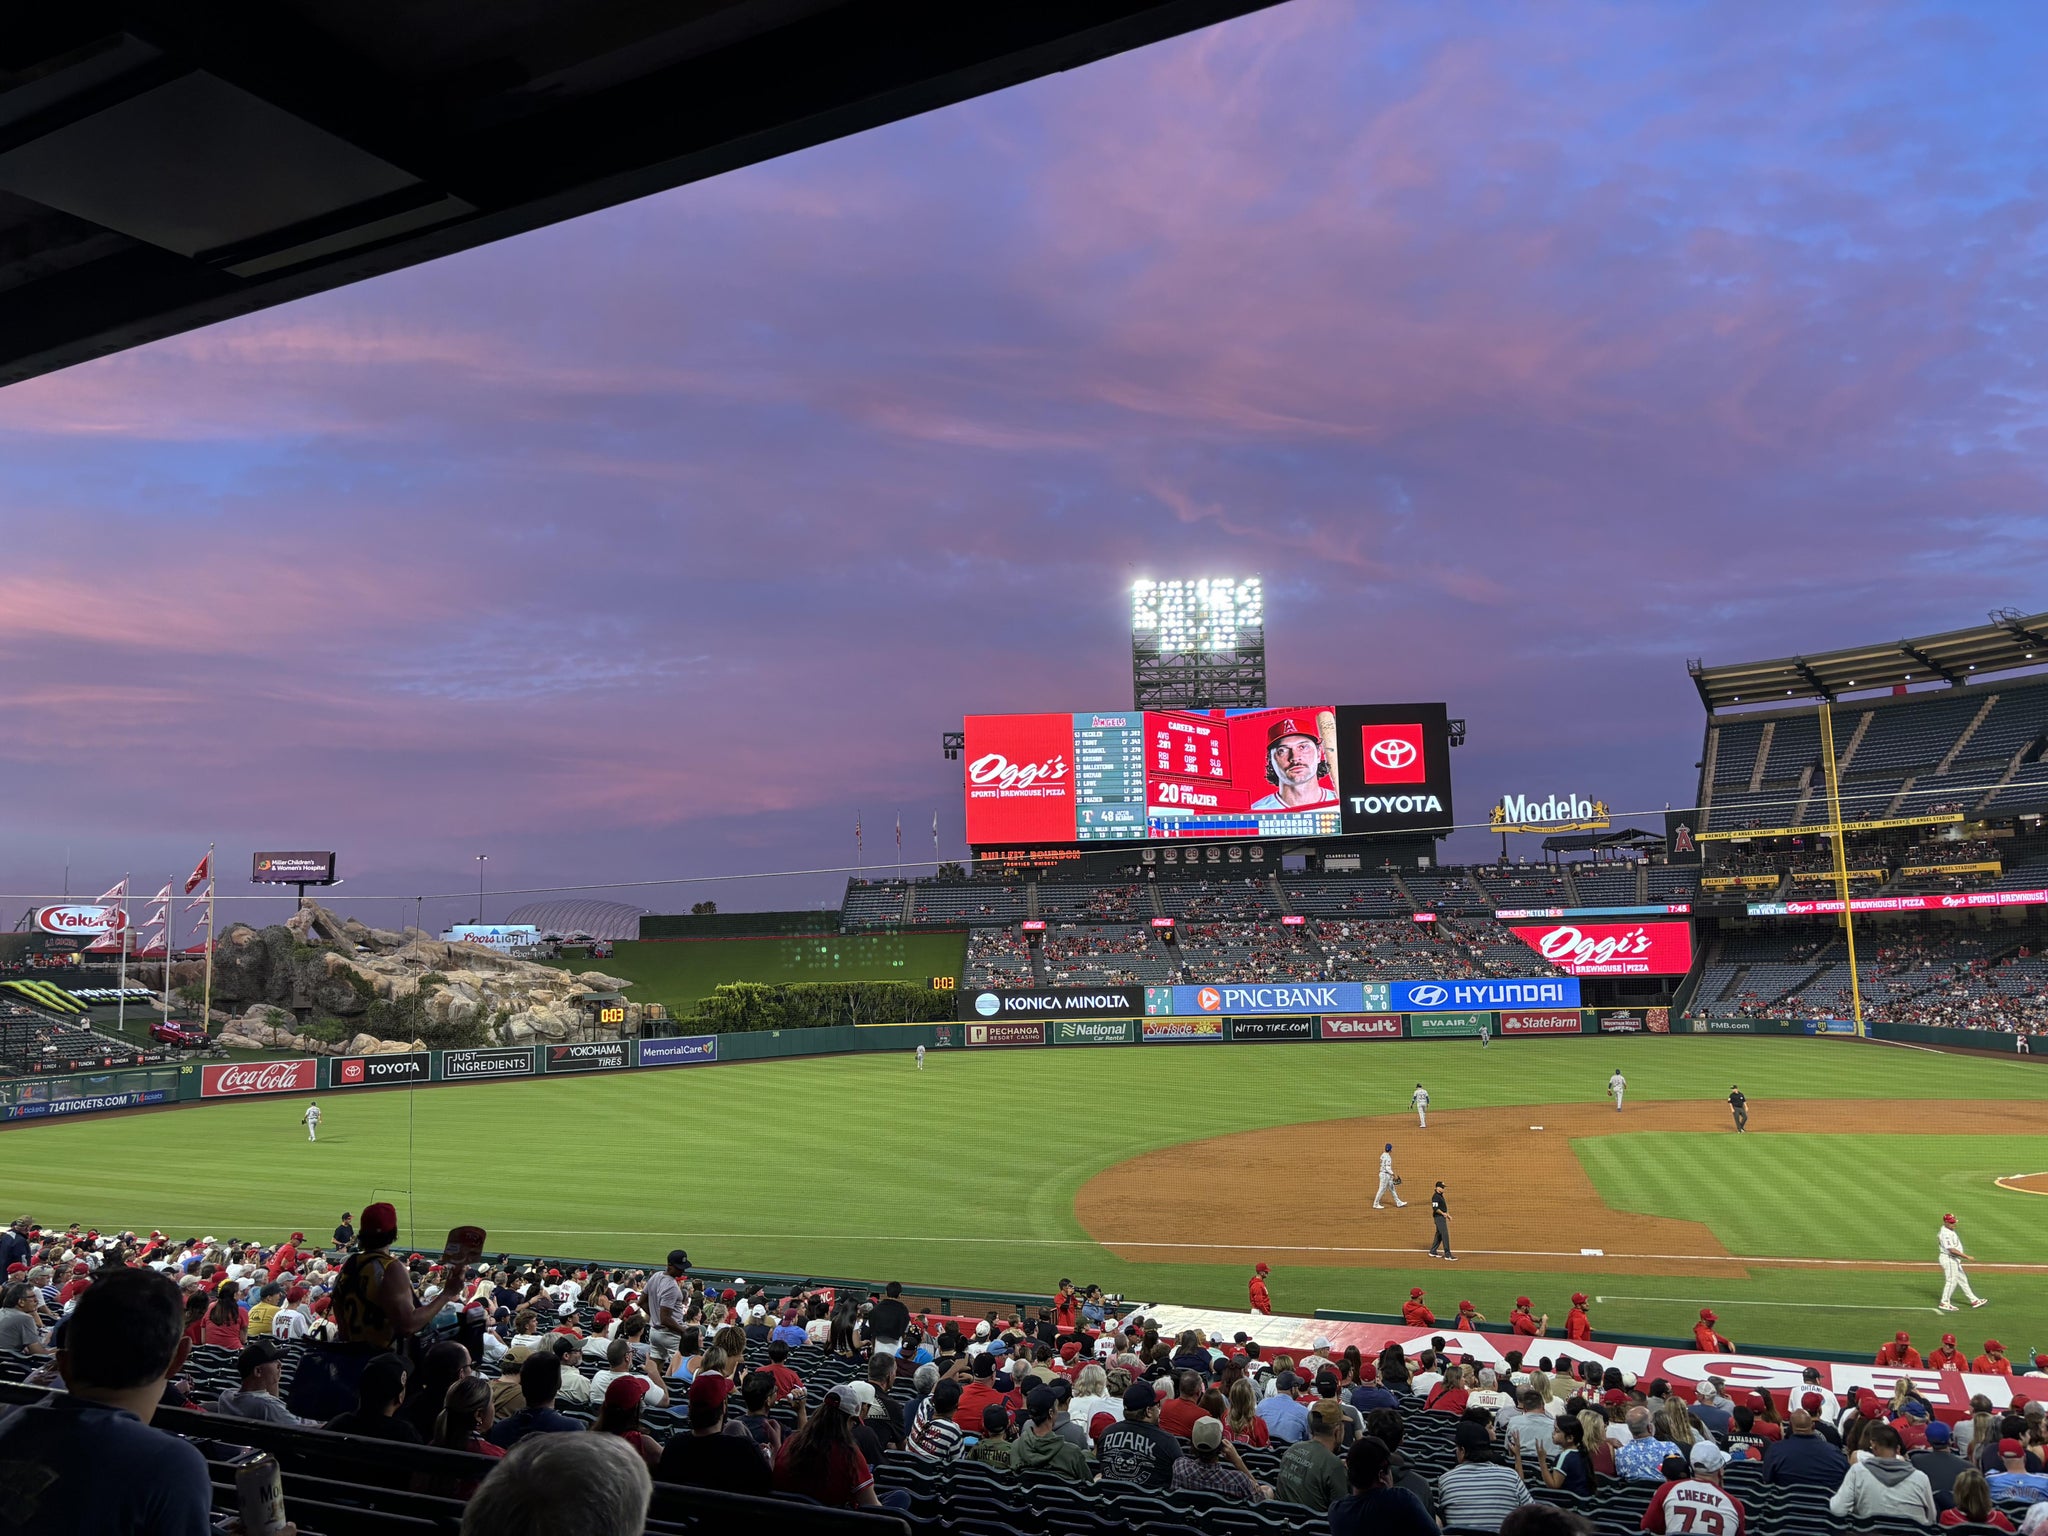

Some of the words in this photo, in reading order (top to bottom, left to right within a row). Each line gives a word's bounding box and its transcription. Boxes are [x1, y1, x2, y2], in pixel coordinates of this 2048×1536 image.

[1092, 715, 1126, 728] ANGELS
[1157, 731, 1170, 740] AVG
[1187, 735, 1192, 743] H
[1158, 751, 1169, 760] RBI
[1184, 754, 1197, 764] OBP
[1209, 758, 1222, 768] SLG
[968, 753, 1070, 789] Oggi's
[970, 788, 996, 798] SPORTS
[1000, 787, 1042, 797] BREWHOUSE
[1046, 788, 1065, 797] PIZZA
[1158, 782, 1179, 803] 20
[1181, 791, 1218, 807] FRAZIER
[1350, 795, 1443, 814] TOYOTA
[1504, 793, 1593, 823] Modelo
[1101, 810, 1114, 821] 48
[1149, 818, 1157, 827] T
[1030, 849, 1081, 860] BOURBON
[1145, 851, 1152, 859] 11
[1166, 850, 1175, 858] 26
[1208, 849, 1219, 857] 30
[1229, 848, 1240, 856] 42
[1251, 848, 1262, 856] 50
[1816, 902, 1845, 910] SPORTS
[1850, 900, 1897, 910] BREWHOUSE
[1902, 898, 1926, 908] PIZZA
[1968, 895, 1996, 904] SPORTS
[2000, 892, 2045, 902] BREWHOUSE
[1526, 909, 1545, 917] METER
[464, 932, 495, 944] Coors
[496, 935, 526, 945] LIGHT
[1539, 926, 1653, 965] Oggi's
[1575, 965, 1622, 973] BREWHOUSE
[1626, 964, 1649, 972] PIZZA
[933, 977, 954, 990] 0:03
[1380, 985, 1386, 994] 0
[68, 987, 157, 998] MONSTER
[1163, 990, 1169, 998] 7
[1223, 988, 1273, 1008] PNC
[1274, 987, 1338, 1007] BANK
[1455, 984, 1563, 1004] HYUNDAI
[1005, 996, 1062, 1010] KONICA
[1065, 995, 1130, 1009] MINOLTA
[1381, 1001, 1387, 1010] 0
[601, 1008, 624, 1023] 0:03
[990, 1027, 1039, 1035] PECHANGA
[1076, 1022, 1126, 1036] National
[1146, 1022, 1193, 1036] Surfside
[1235, 1024, 1263, 1033] NITTO
[1265, 1023, 1309, 1033] TIRE.COM
[1326, 1020, 1396, 1033] Yakult
[1711, 1022, 1750, 1030] FMB.com
[570, 1044, 622, 1057] YOKOHAMA
[643, 1045, 703, 1057] MemorialCare
[112, 1057, 129, 1065] TUNDRA
[453, 1052, 477, 1062] JUST
[598, 1057, 623, 1067] TIRES
[78, 1060, 96, 1068] TUNDRA
[181, 1066, 193, 1074] 390
[369, 1062, 420, 1075] TOYOTA
[453, 1059, 526, 1073] INGREDIENTS
[217, 1062, 302, 1092] Coca-Cola
[49, 1095, 127, 1113] 714TICKETS.COM
[276, 1327, 289, 1339] 14
[1800, 1385, 1823, 1393] OHTANI
[1479, 1396, 1498, 1405] TROUT
[1103, 1431, 1157, 1460] ROARK
[1676, 1489, 1723, 1508] CHEEKY
[1674, 1505, 1724, 1533] 73
